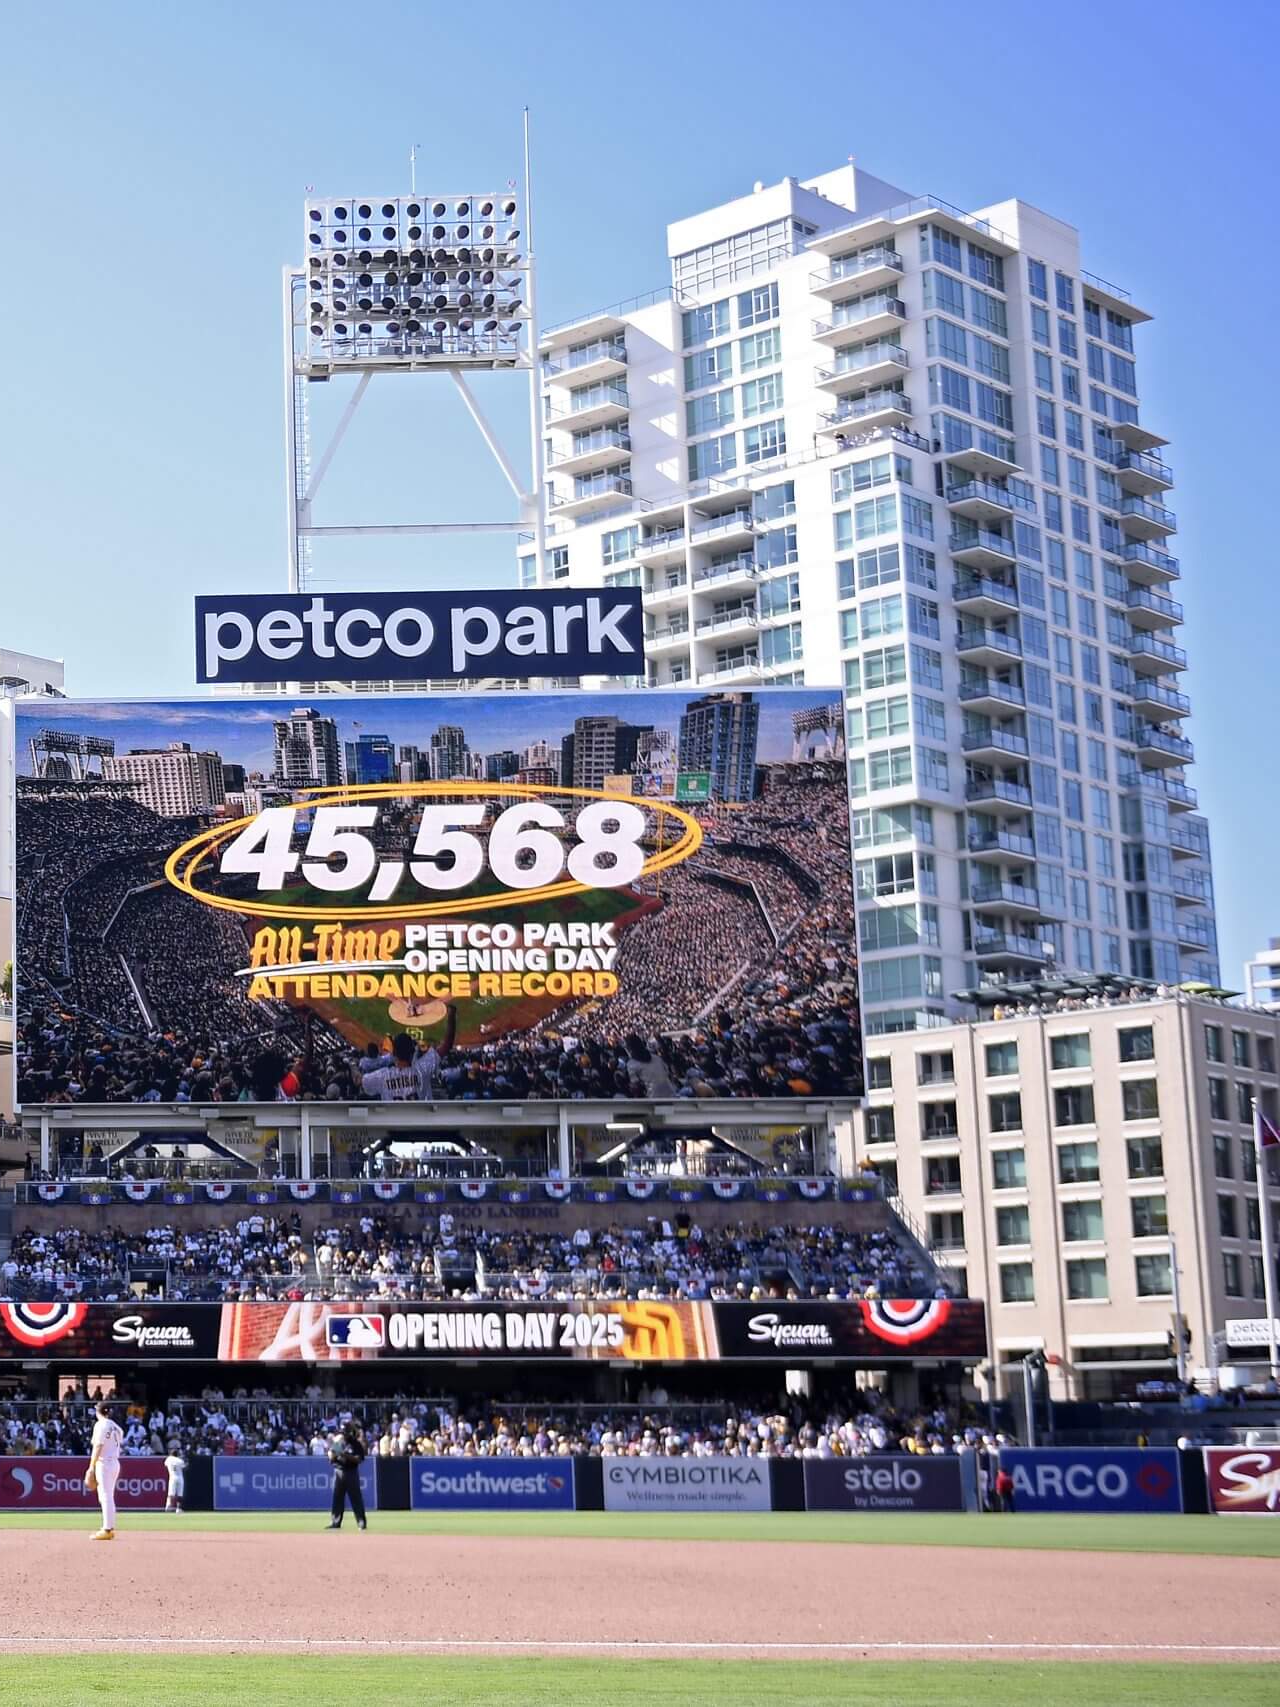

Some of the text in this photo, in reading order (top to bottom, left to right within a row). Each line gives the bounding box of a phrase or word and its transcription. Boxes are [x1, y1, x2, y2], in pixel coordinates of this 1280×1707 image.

[204, 597, 635, 678] petco park
[219, 801, 646, 901] 45,568
[250, 921, 402, 969] All-Time
[405, 921, 617, 949] PETCO PARK
[404, 947, 618, 973] OPENING DAY
[248, 971, 618, 999] ATTENDANCE RECORD
[112, 1315, 192, 1347] Sycuan
[388, 1312, 624, 1349] OPENING DAY 2025
[747, 1313, 829, 1347] Sycuan
[42, 1474, 167, 1496] Snapagon
[420, 1471, 547, 1493] Southwest
[609, 1466, 762, 1484] CYMBIOTIKA
[844, 1461, 922, 1491] stelo
[1012, 1463, 1129, 1498] ARCO
[626, 1490, 676, 1501] Wellness
[677, 1491, 707, 1501] made
[854, 1495, 867, 1507] by
